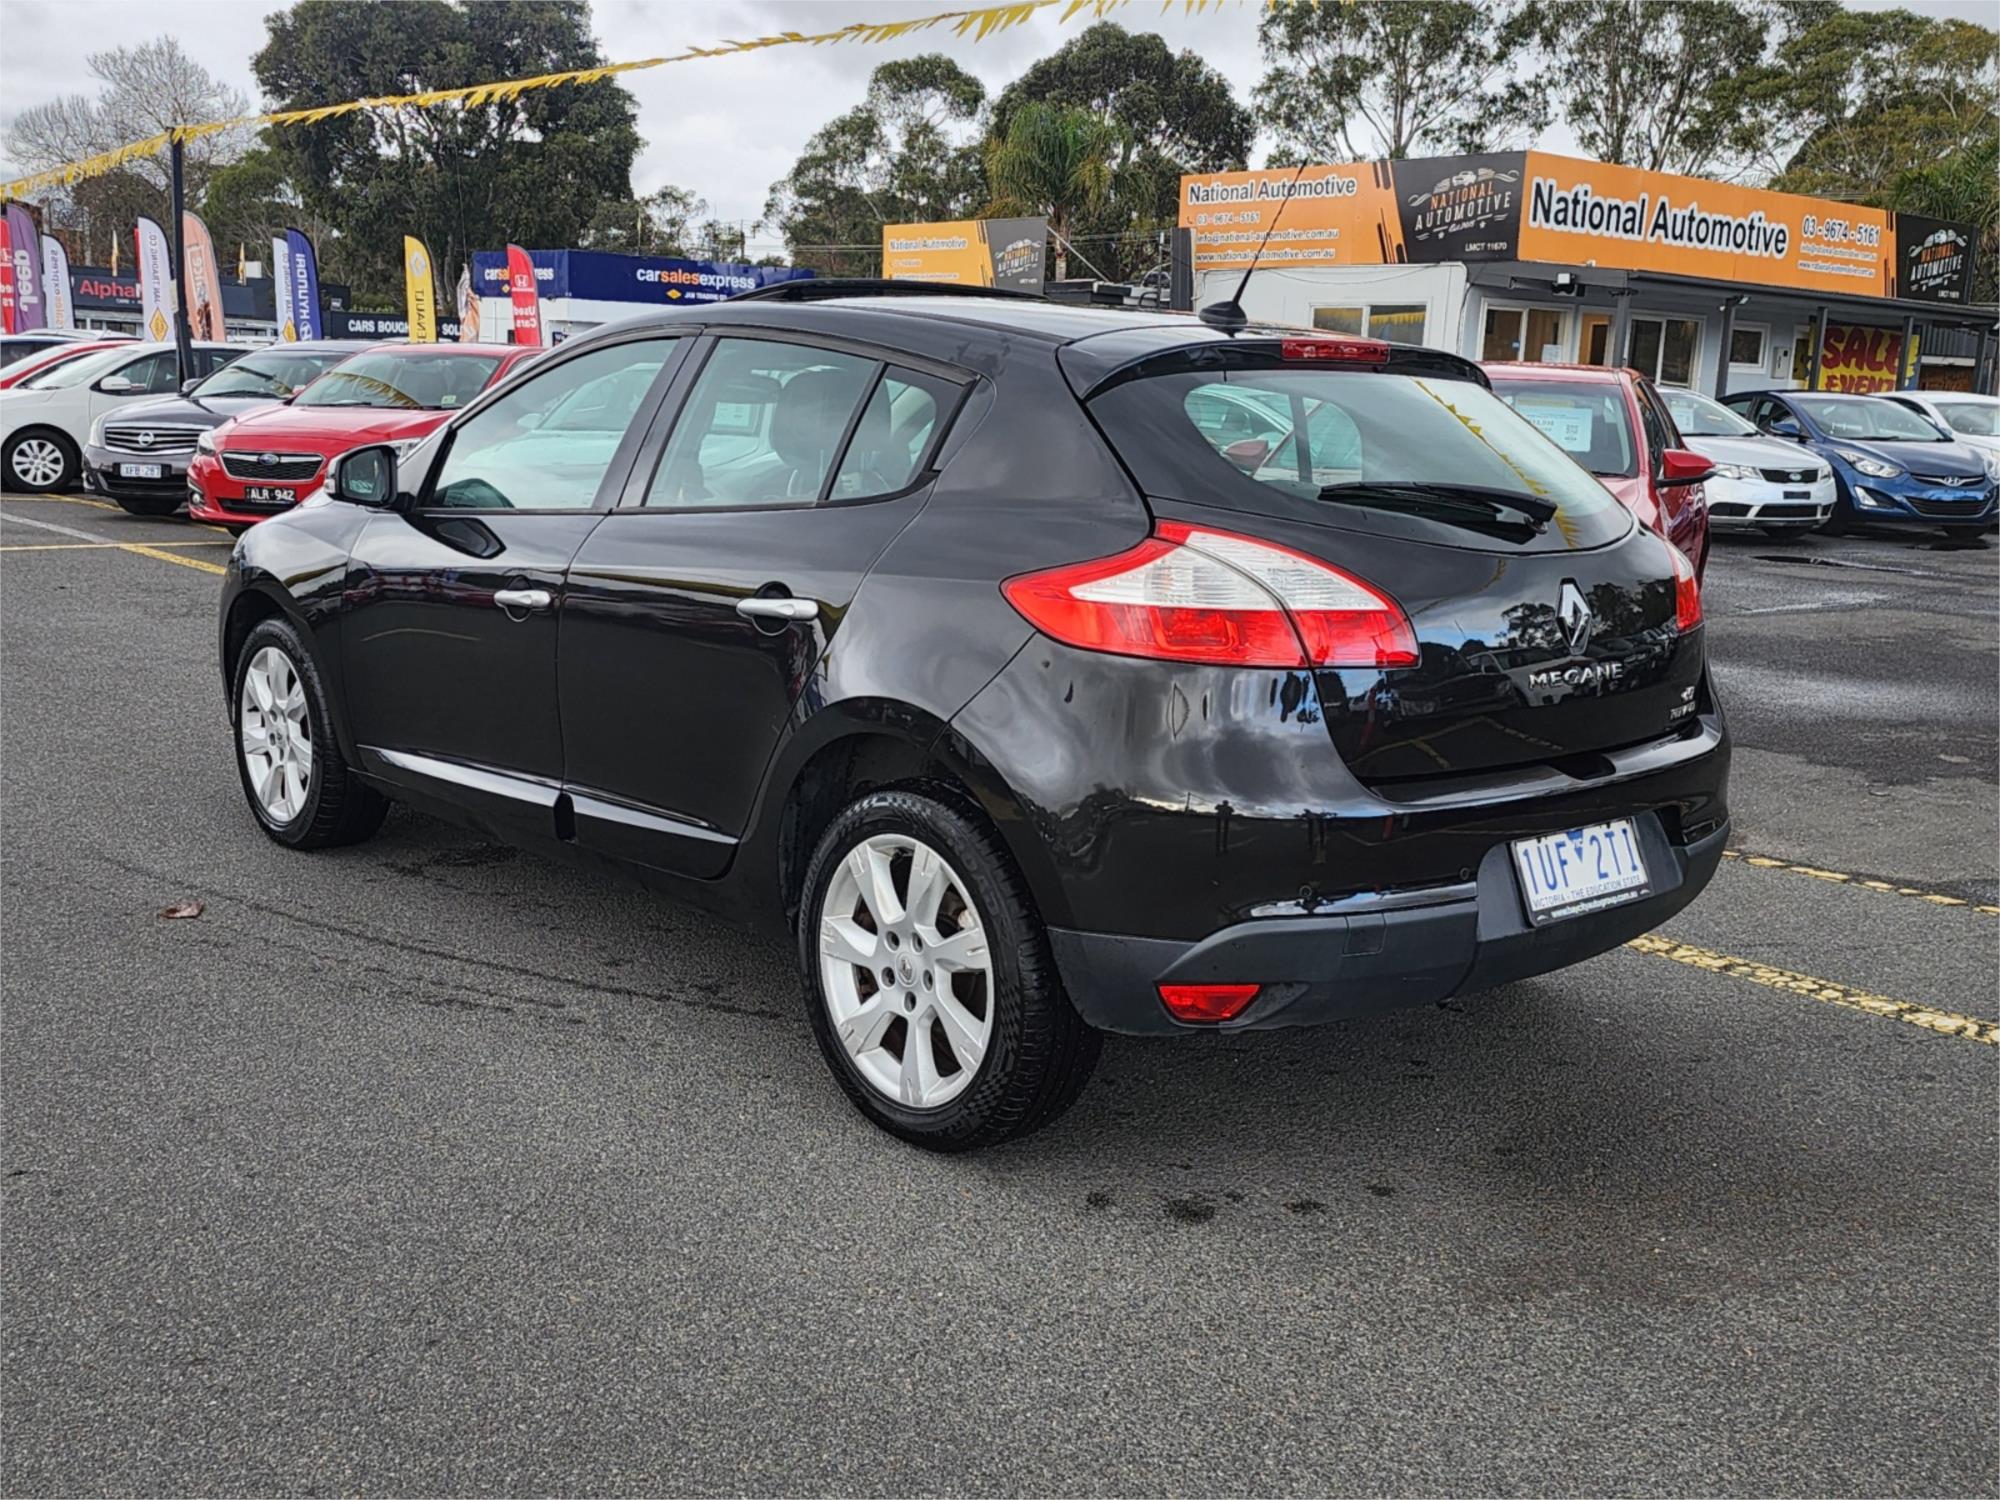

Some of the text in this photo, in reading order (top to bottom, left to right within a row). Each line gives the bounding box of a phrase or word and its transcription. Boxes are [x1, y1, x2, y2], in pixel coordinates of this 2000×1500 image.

[1188, 176, 1356, 204] National Automotive
[1430, 181, 1494, 210] NATIONAL
[1415, 191, 1512, 231] AUTOMOTIVE
[1531, 180, 1788, 255] National Automotive
[890, 237, 967, 251] National Automotive
[1197, 230, 1339, 244] info@national-auomotive.com.au
[1803, 216, 1816, 237] 03
[1823, 219, 1849, 240] 9674
[1856, 224, 1880, 245] 5161
[636, 268, 756, 290] carsalesexpress
[1910, 254, 1963, 281] AUTOMOTIVE
[348, 319, 375, 333] CARS
[1821, 325, 1902, 375] SALE
[1825, 374, 1895, 395] EVENT
[251, 488, 296, 501] ALR 942
[1529, 663, 1624, 690] MEGANE
[1571, 887, 1585, 898] THE
[1585, 880, 1622, 897] EDUCATION
[1622, 874, 1641, 888] STATE
